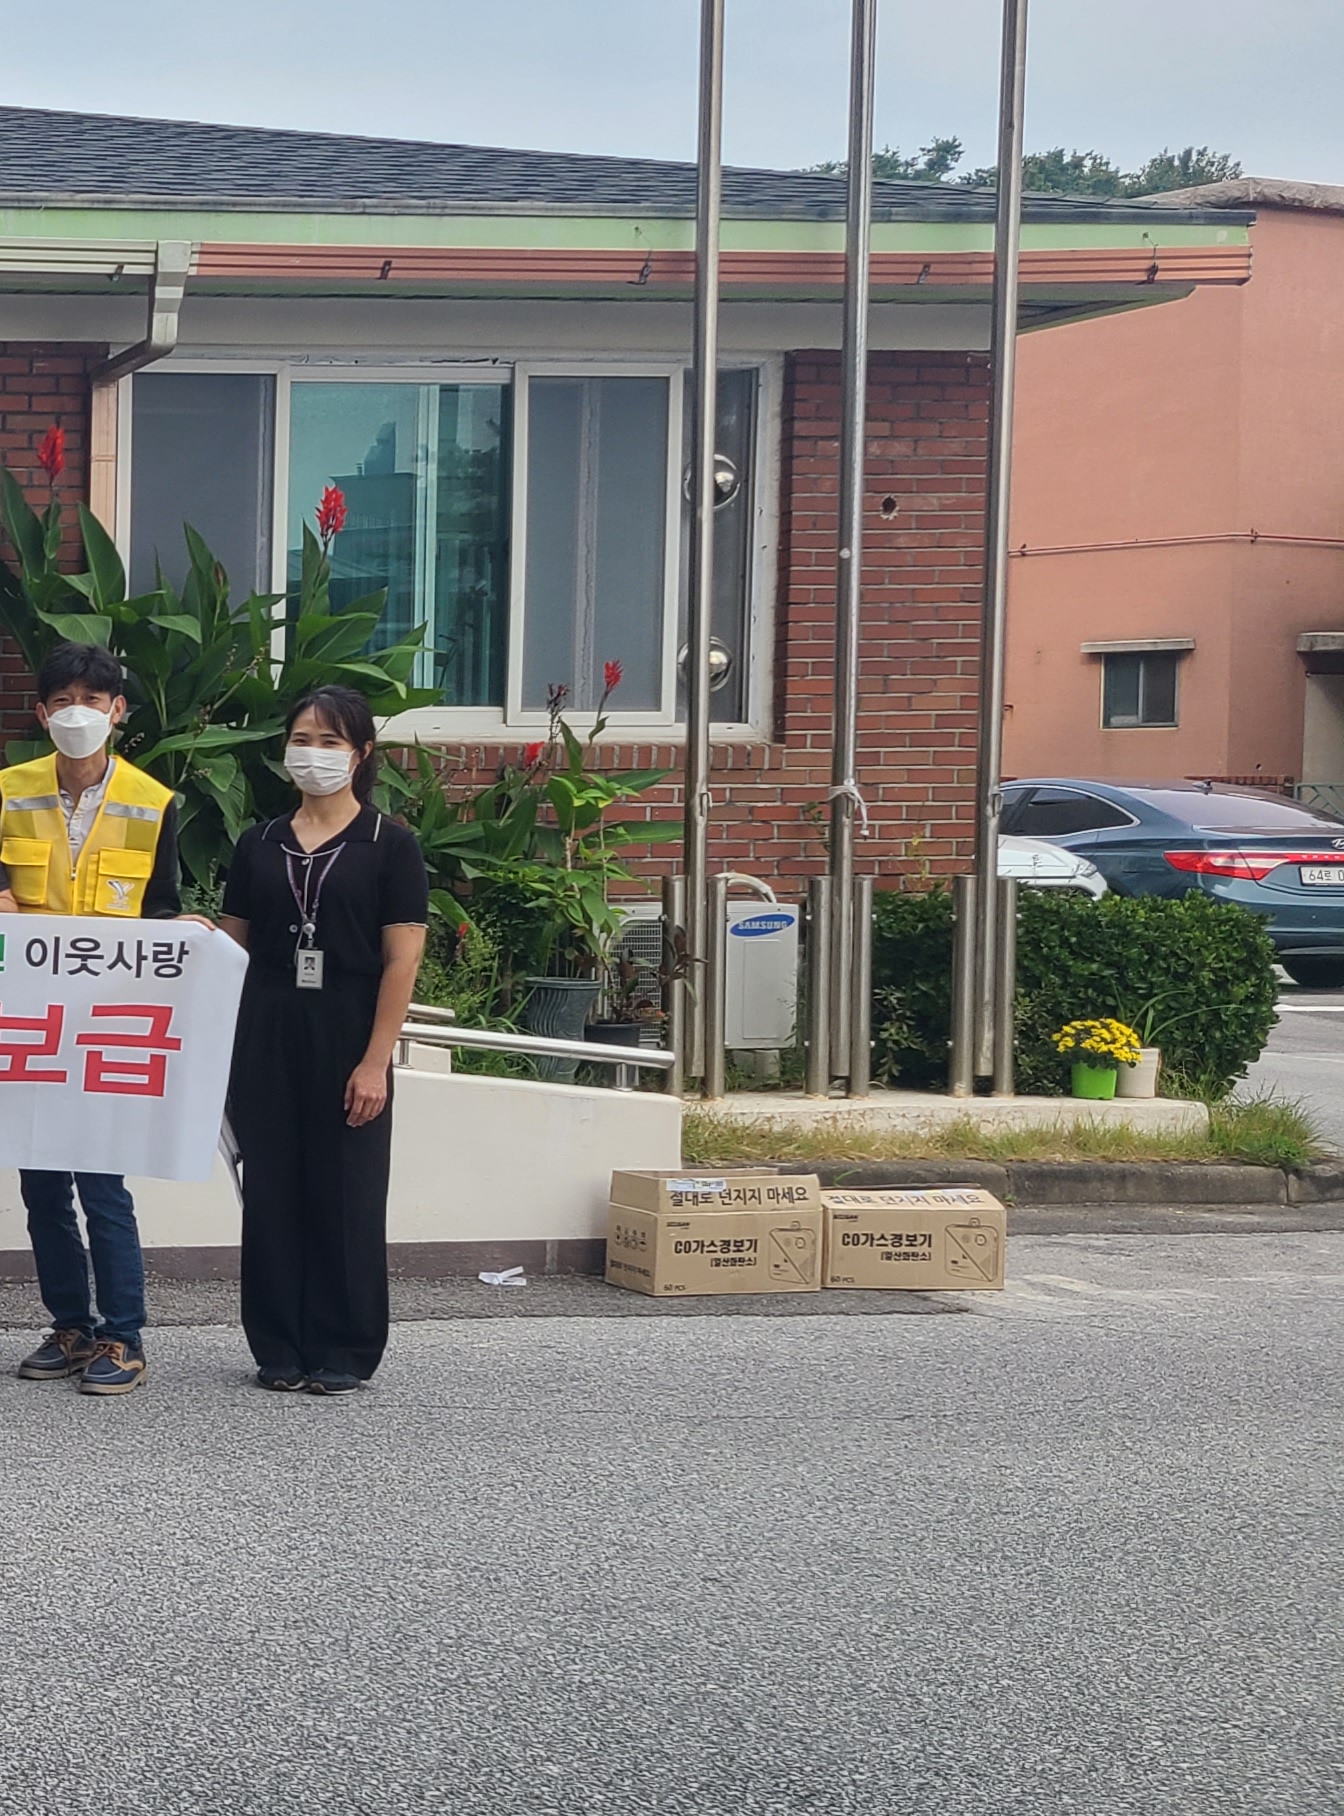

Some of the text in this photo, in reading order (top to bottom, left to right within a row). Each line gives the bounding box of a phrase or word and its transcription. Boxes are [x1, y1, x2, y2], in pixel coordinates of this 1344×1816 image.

[738, 921, 788, 930] SAMSUNG
[24, 935, 190, 979] 이웃사랑
[767, 1186, 809, 1205] 마세요
[932, 1194, 984, 1205] 마세요
[674, 1238, 759, 1254] CO가스경보기
[842, 1232, 932, 1248] CO가스경보기
